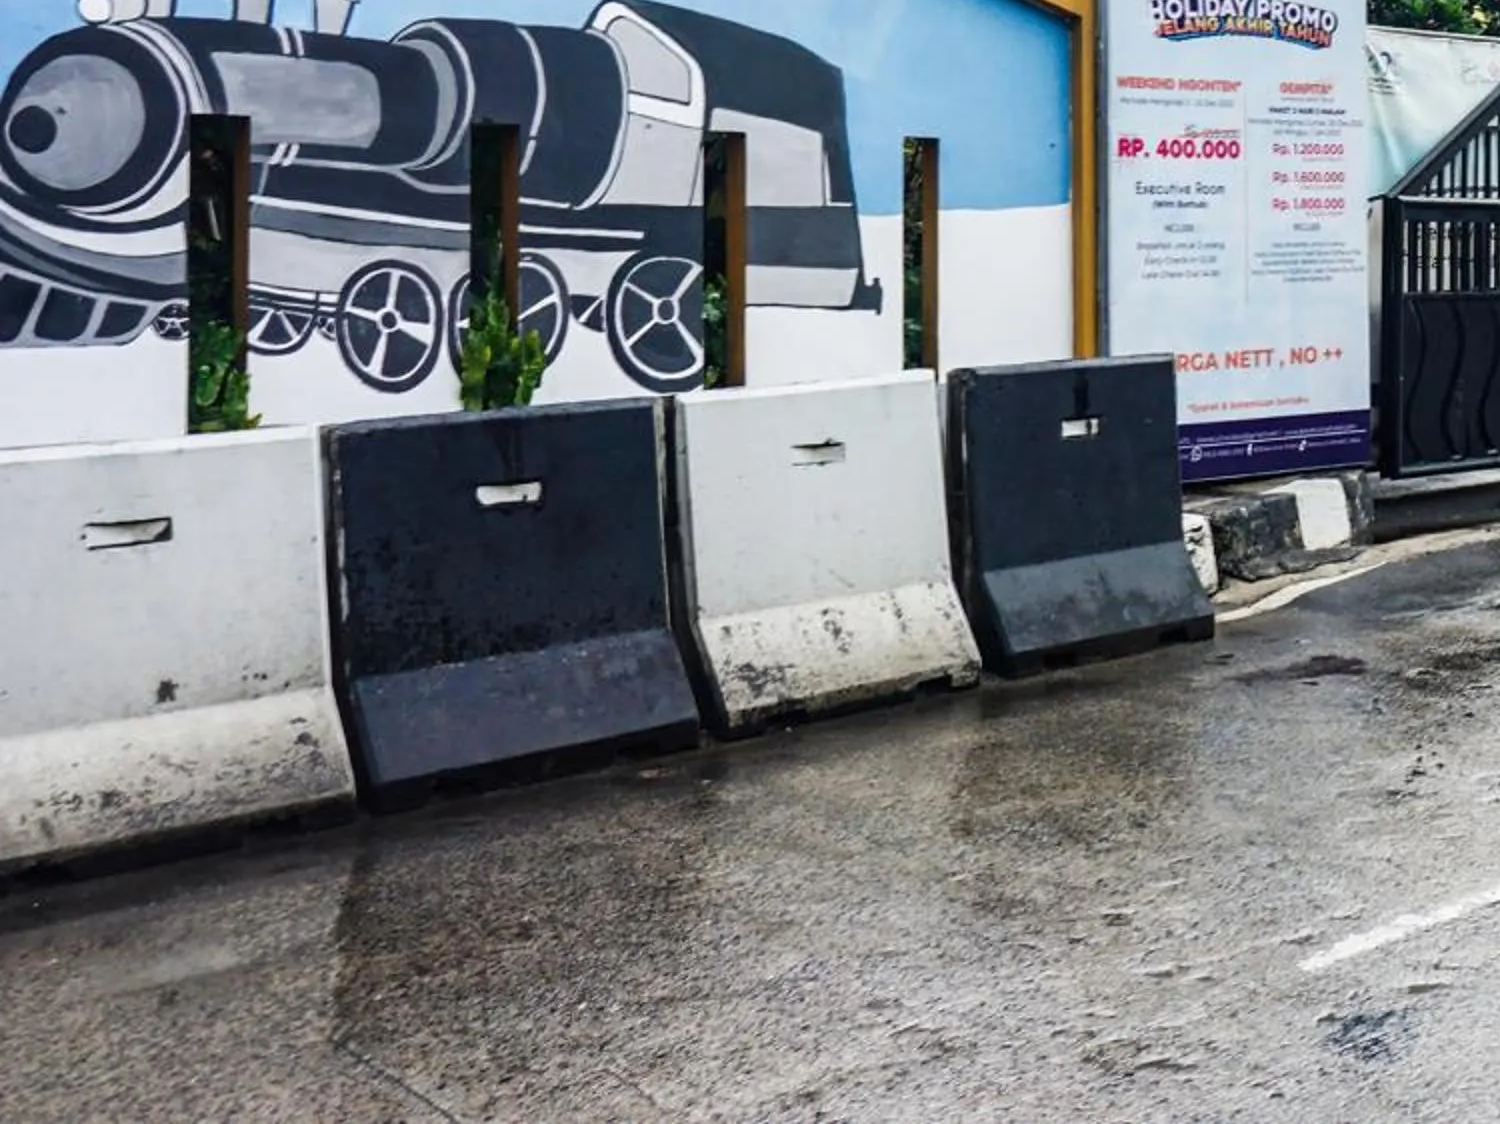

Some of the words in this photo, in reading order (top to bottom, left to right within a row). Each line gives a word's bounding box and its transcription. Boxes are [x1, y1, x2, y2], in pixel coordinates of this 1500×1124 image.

[1154, 17, 1219, 38] JELANG
[1224, 17, 1273, 36] AKHIR
[1279, 22, 1333, 48] TAHUN
[1117, 137, 1149, 158] RP.
[1156, 139, 1240, 159] 400.000
[1176, 353, 1219, 373] RGA
[1289, 346, 1317, 366] NO
